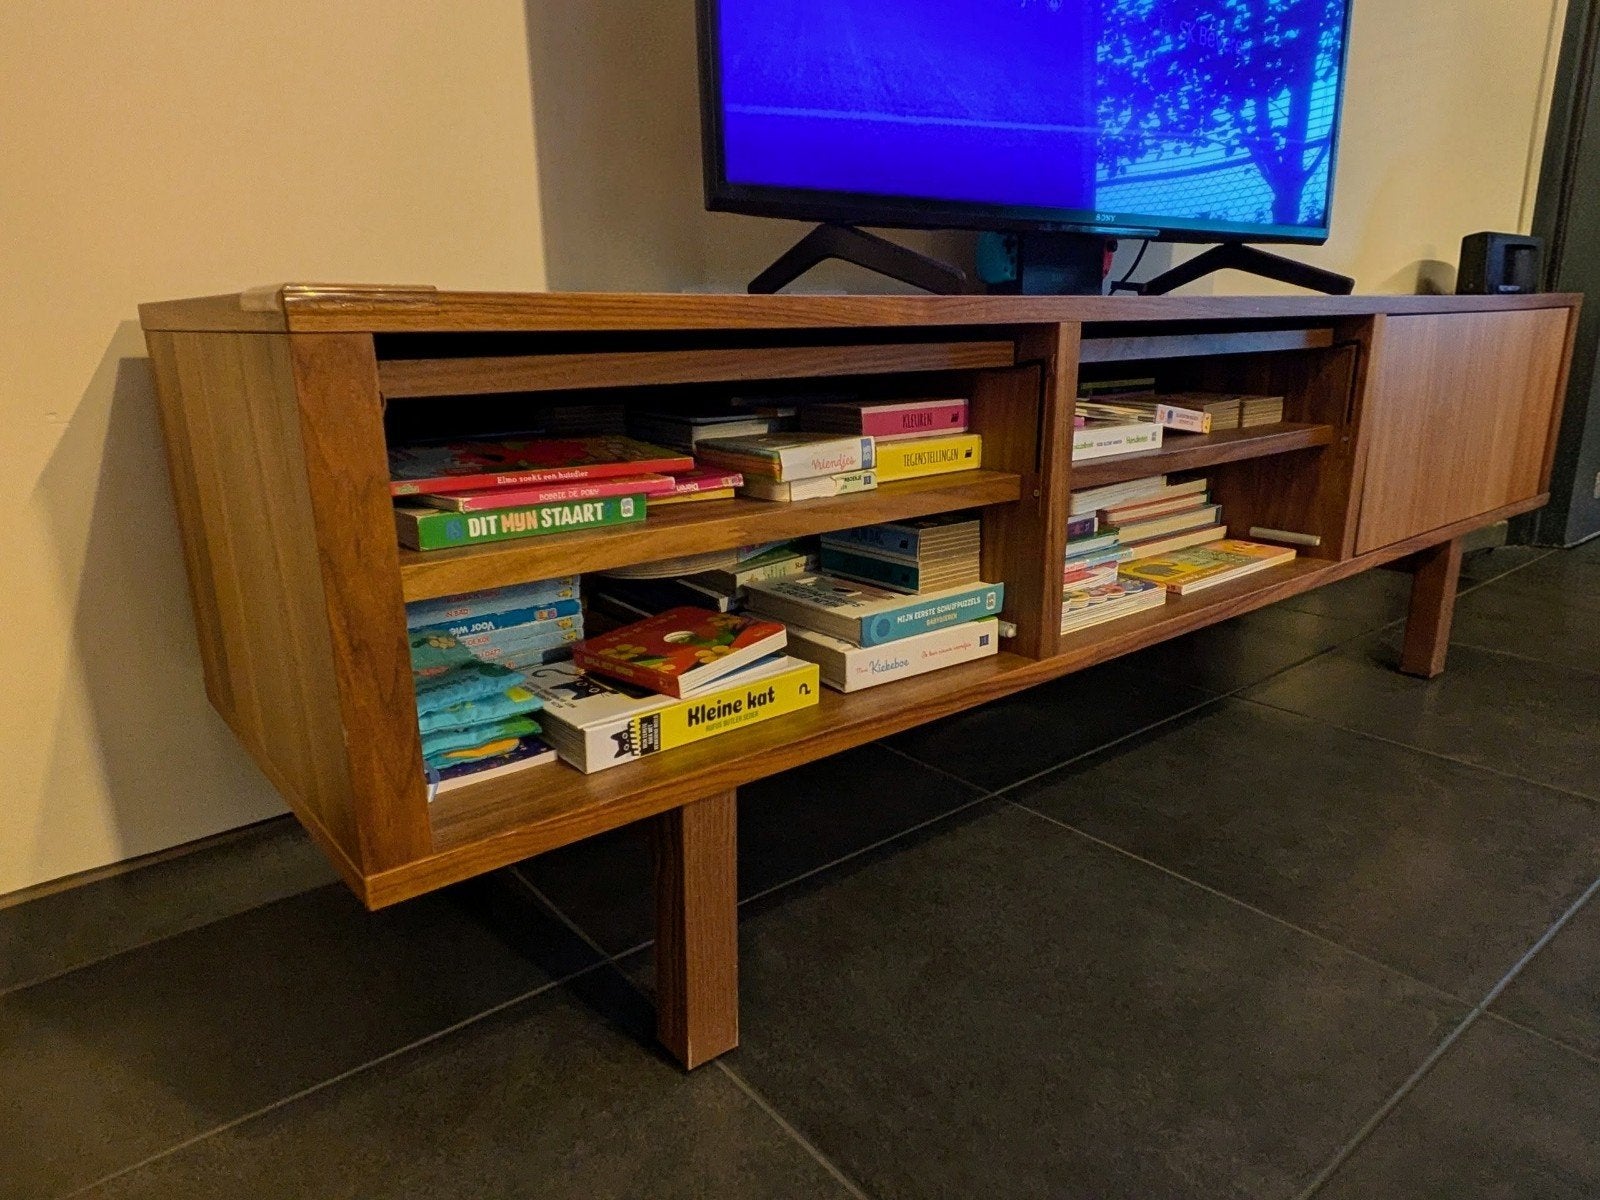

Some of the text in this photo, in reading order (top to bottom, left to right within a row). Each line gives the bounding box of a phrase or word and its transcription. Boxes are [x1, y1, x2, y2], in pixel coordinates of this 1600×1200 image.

[1095, 213, 1117, 222] SONY
[902, 412, 933, 428] KLEUREN
[904, 447, 959, 467] TEGENSTELLINGEN
[497, 475, 518, 484] Elmo
[467, 515, 499, 538] DIT
[914, 607, 936, 620] EERSTE
[470, 620, 495, 634] Voor
[687, 685, 776, 727] Kleine kat
